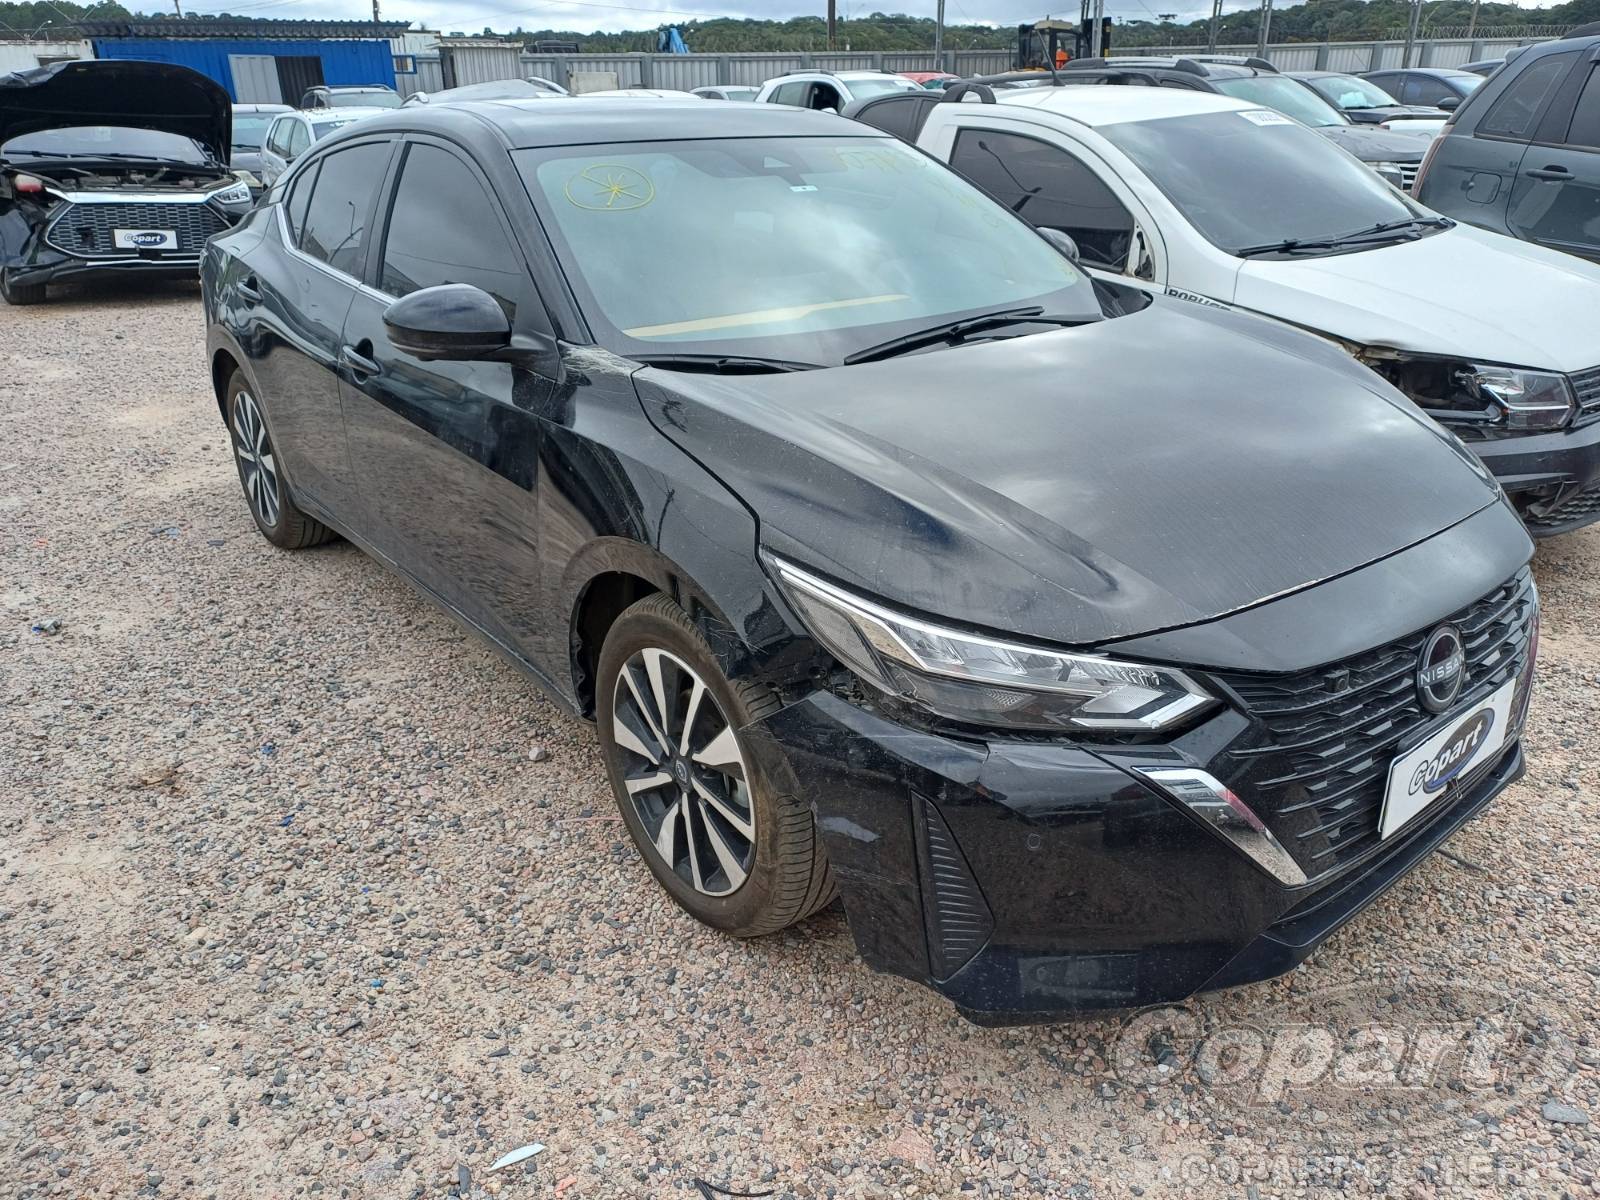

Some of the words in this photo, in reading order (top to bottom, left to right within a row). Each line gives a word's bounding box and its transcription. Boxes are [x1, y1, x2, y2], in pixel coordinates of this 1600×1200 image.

[124, 233, 161, 244] Copart
[1420, 653, 1465, 685] NISSAN
[1408, 720, 1485, 796] Copart
